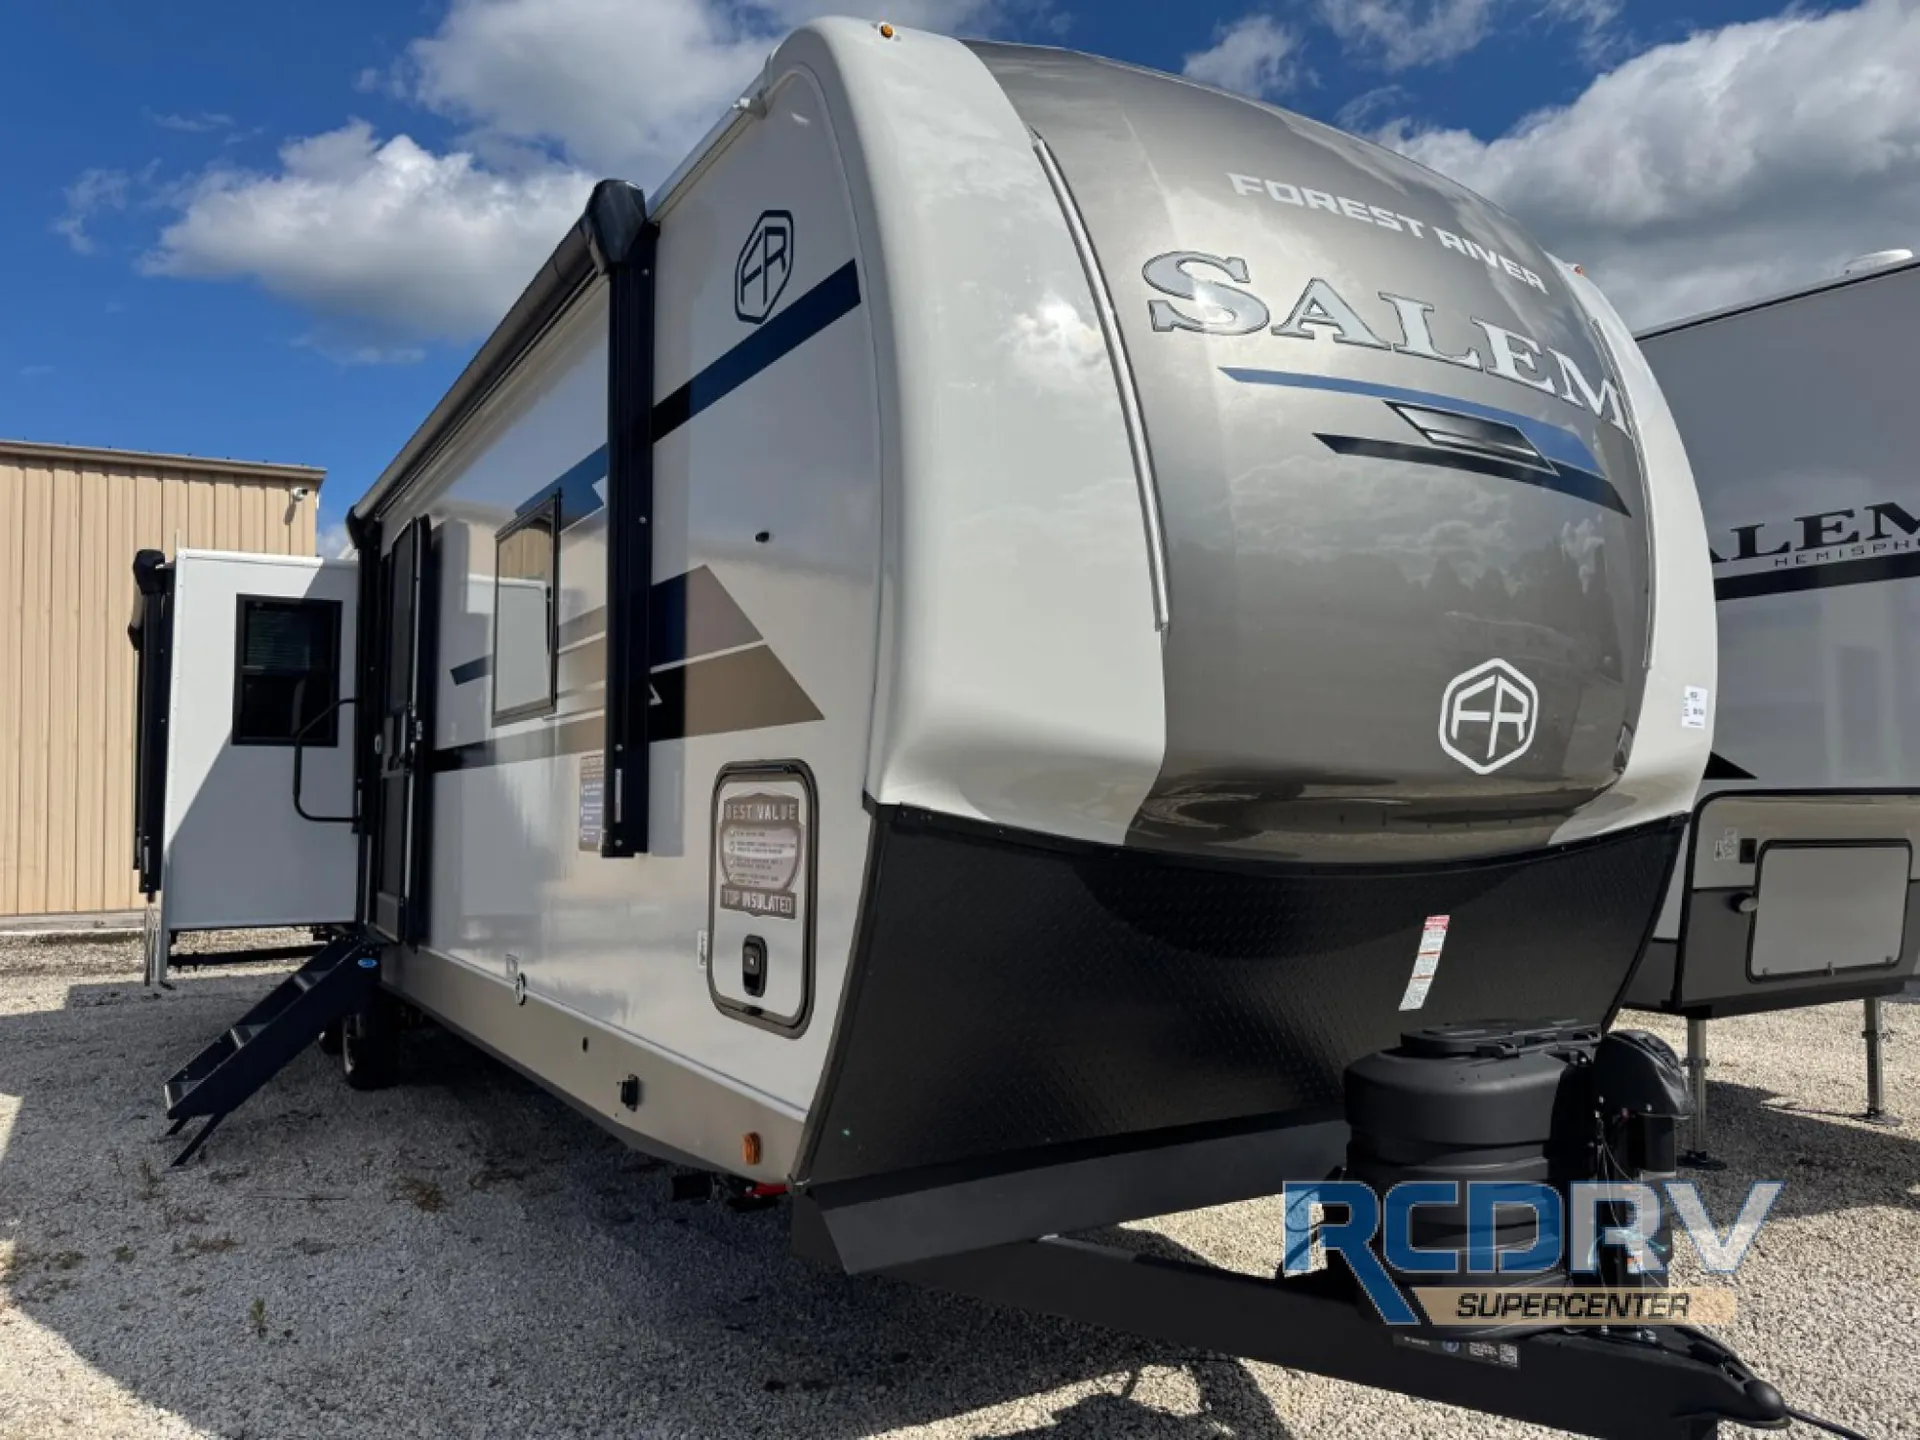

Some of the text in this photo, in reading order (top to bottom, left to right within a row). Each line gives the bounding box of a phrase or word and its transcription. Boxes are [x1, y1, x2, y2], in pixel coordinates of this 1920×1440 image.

[1225, 172, 1549, 294] FOREST RIVER
[1141, 250, 1634, 441] SALEM
[1710, 502, 1920, 563] LEM
[1774, 538, 1920, 567] HEMISPH
[725, 803, 797, 821] BEST VALUE
[742, 891, 793, 914] INSULATED
